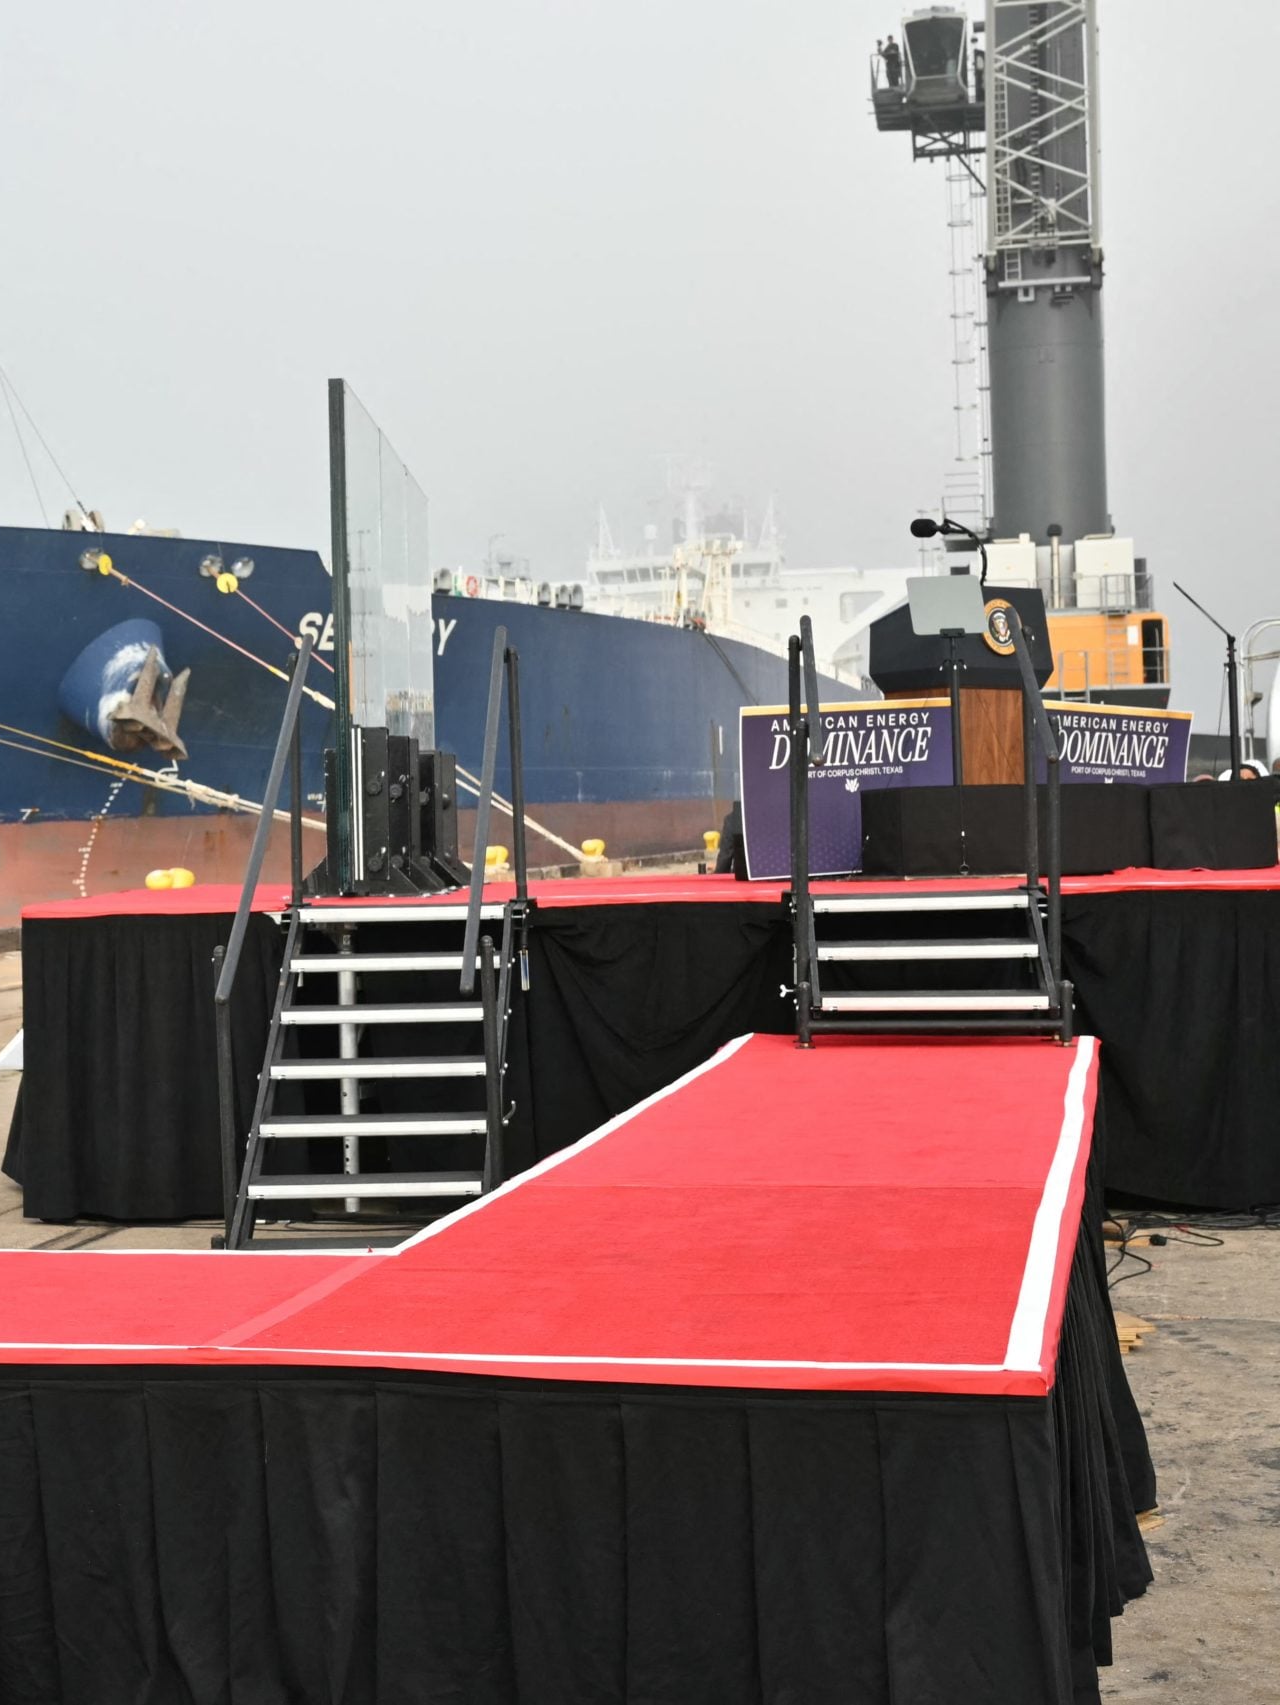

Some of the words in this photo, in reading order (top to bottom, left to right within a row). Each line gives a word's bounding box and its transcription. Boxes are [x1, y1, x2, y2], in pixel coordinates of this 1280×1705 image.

[771, 715, 858, 732] AMICAN
[866, 712, 930, 728] ENERGY
[1121, 719, 1169, 734] ENERGY
[769, 727, 932, 770] DMINANCE
[817, 769, 827, 779] OF
[827, 768, 855, 778] CORPUS
[882, 765, 904, 775] TEXAS
[1071, 765, 1084, 774] PORT
[1084, 766, 1092, 775] OF
[1131, 769, 1147, 778] TEXAS
